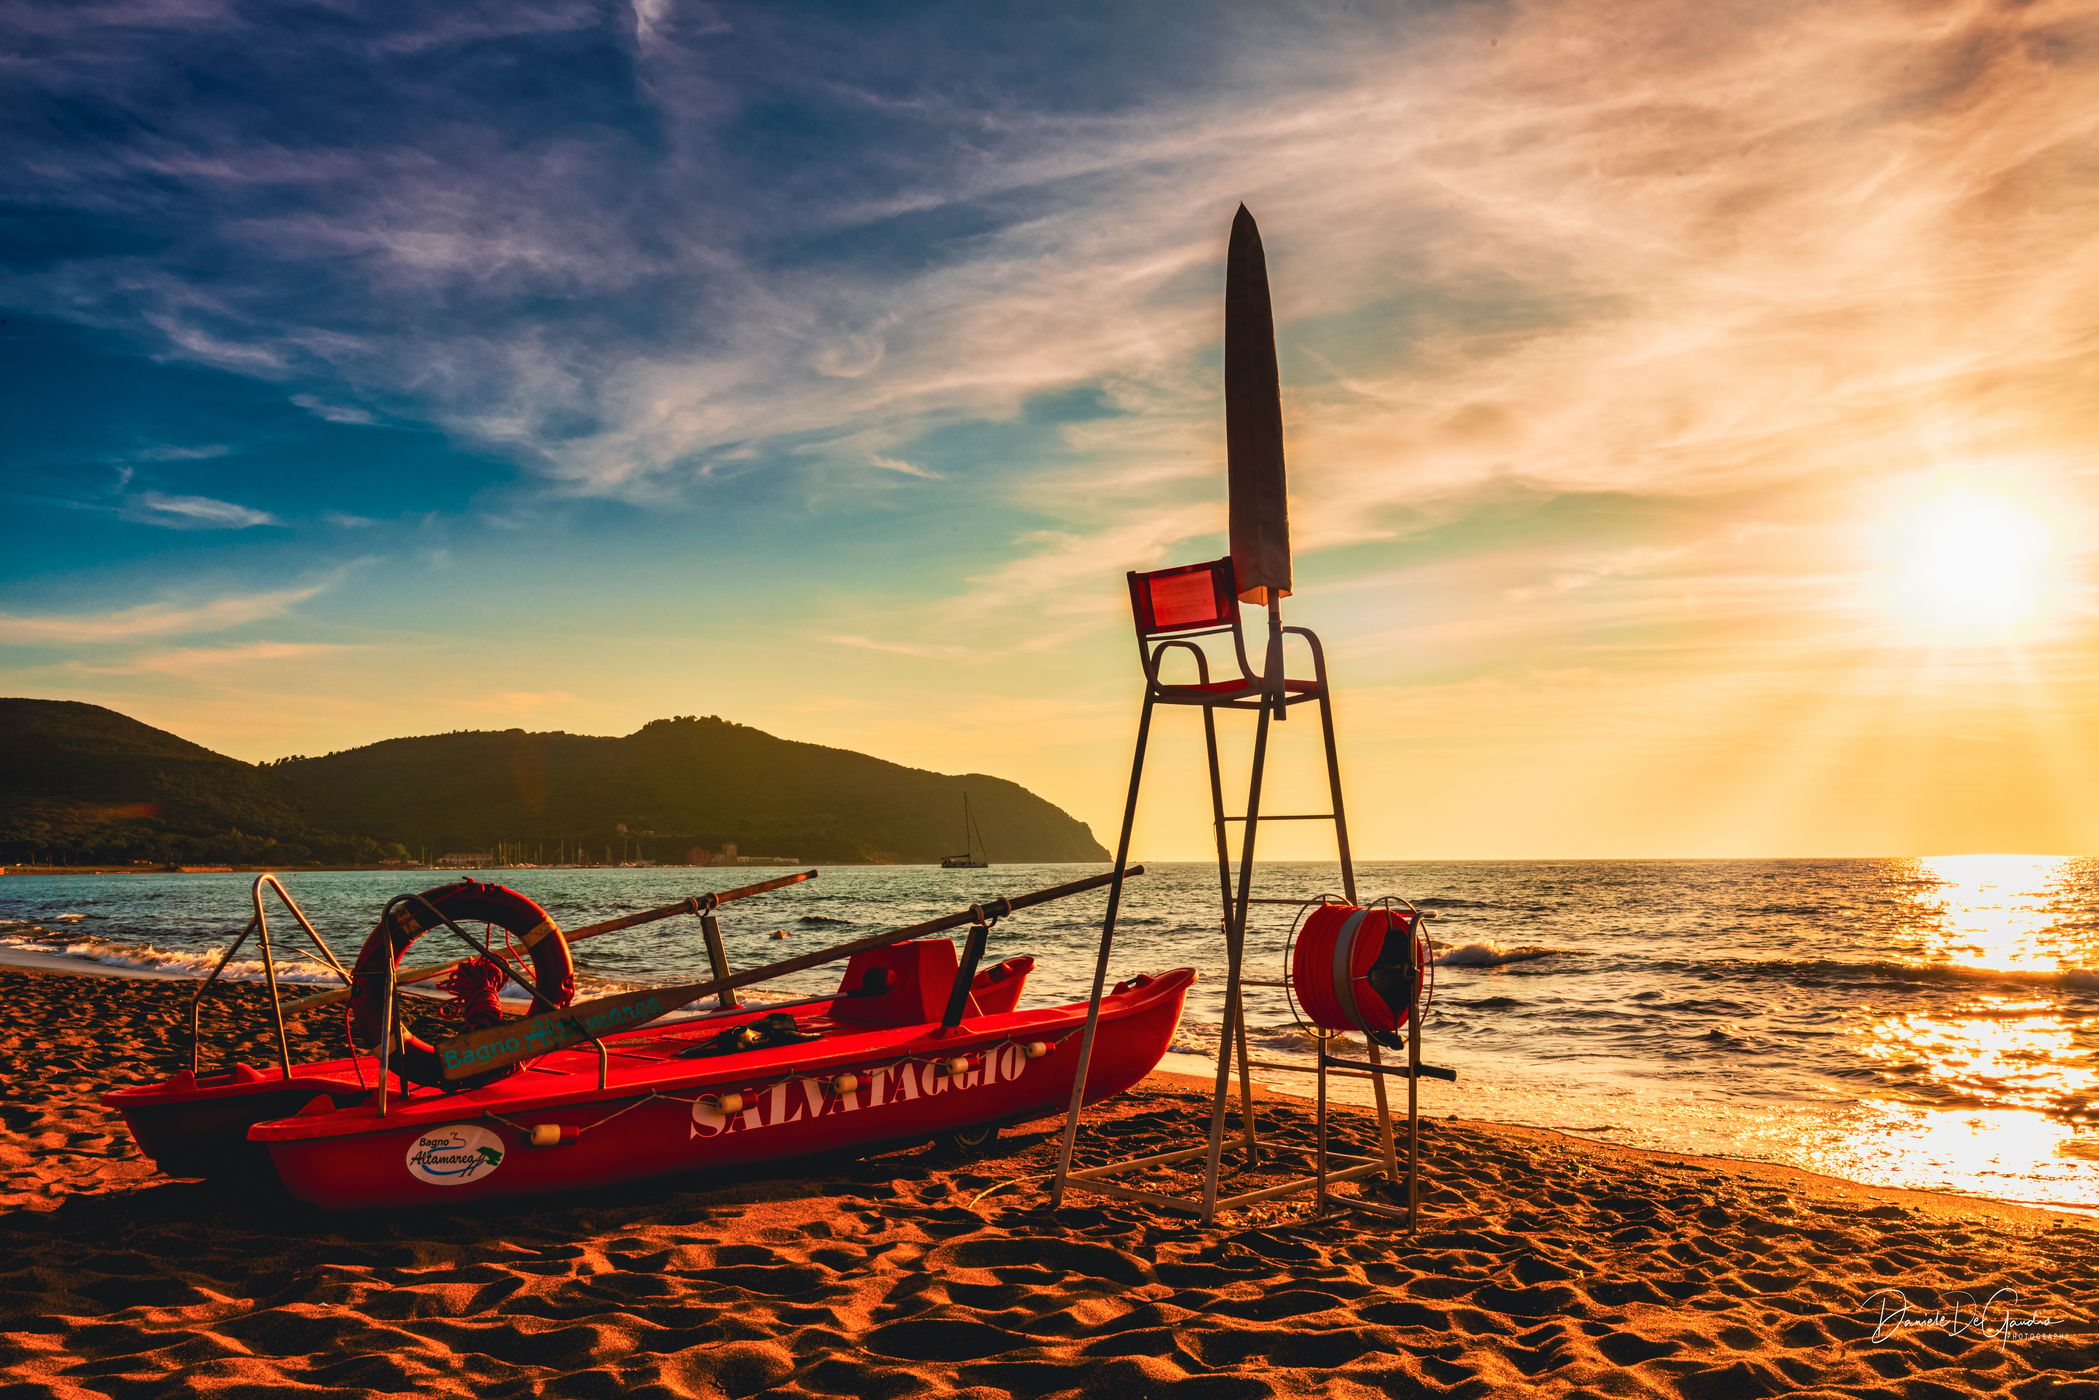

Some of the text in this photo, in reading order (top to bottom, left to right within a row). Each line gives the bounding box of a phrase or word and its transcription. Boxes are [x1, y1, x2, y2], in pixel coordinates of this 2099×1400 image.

[443, 1036, 520, 1070] Bagno
[690, 1045, 1026, 1140] SALVATAGGIO
[419, 1138, 449, 1148] Bagno
